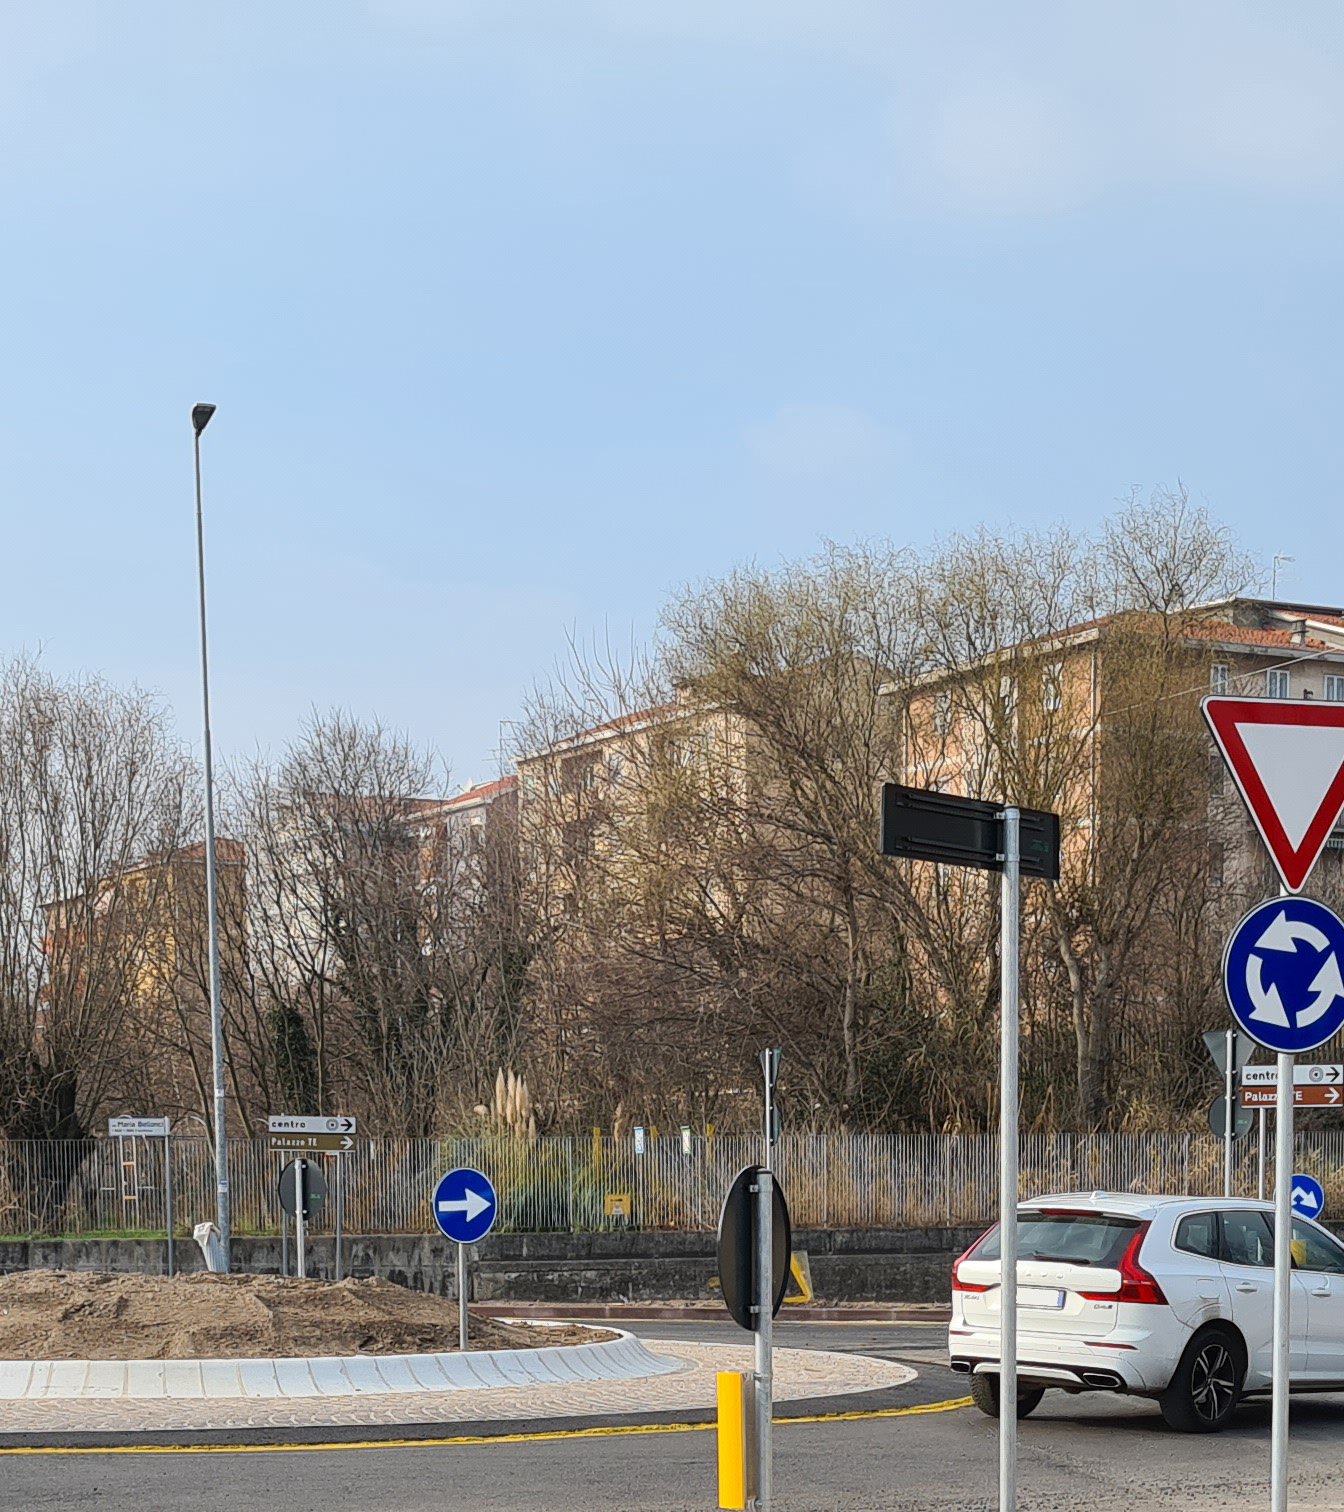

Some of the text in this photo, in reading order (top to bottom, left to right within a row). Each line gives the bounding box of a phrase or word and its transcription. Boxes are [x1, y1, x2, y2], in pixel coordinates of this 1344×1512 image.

[1245, 1070, 1278, 1081] centr
[1244, 1091, 1278, 1102] Palazz
[271, 1120, 306, 1129] centro
[271, 1137, 318, 1147] Palazzo TE
